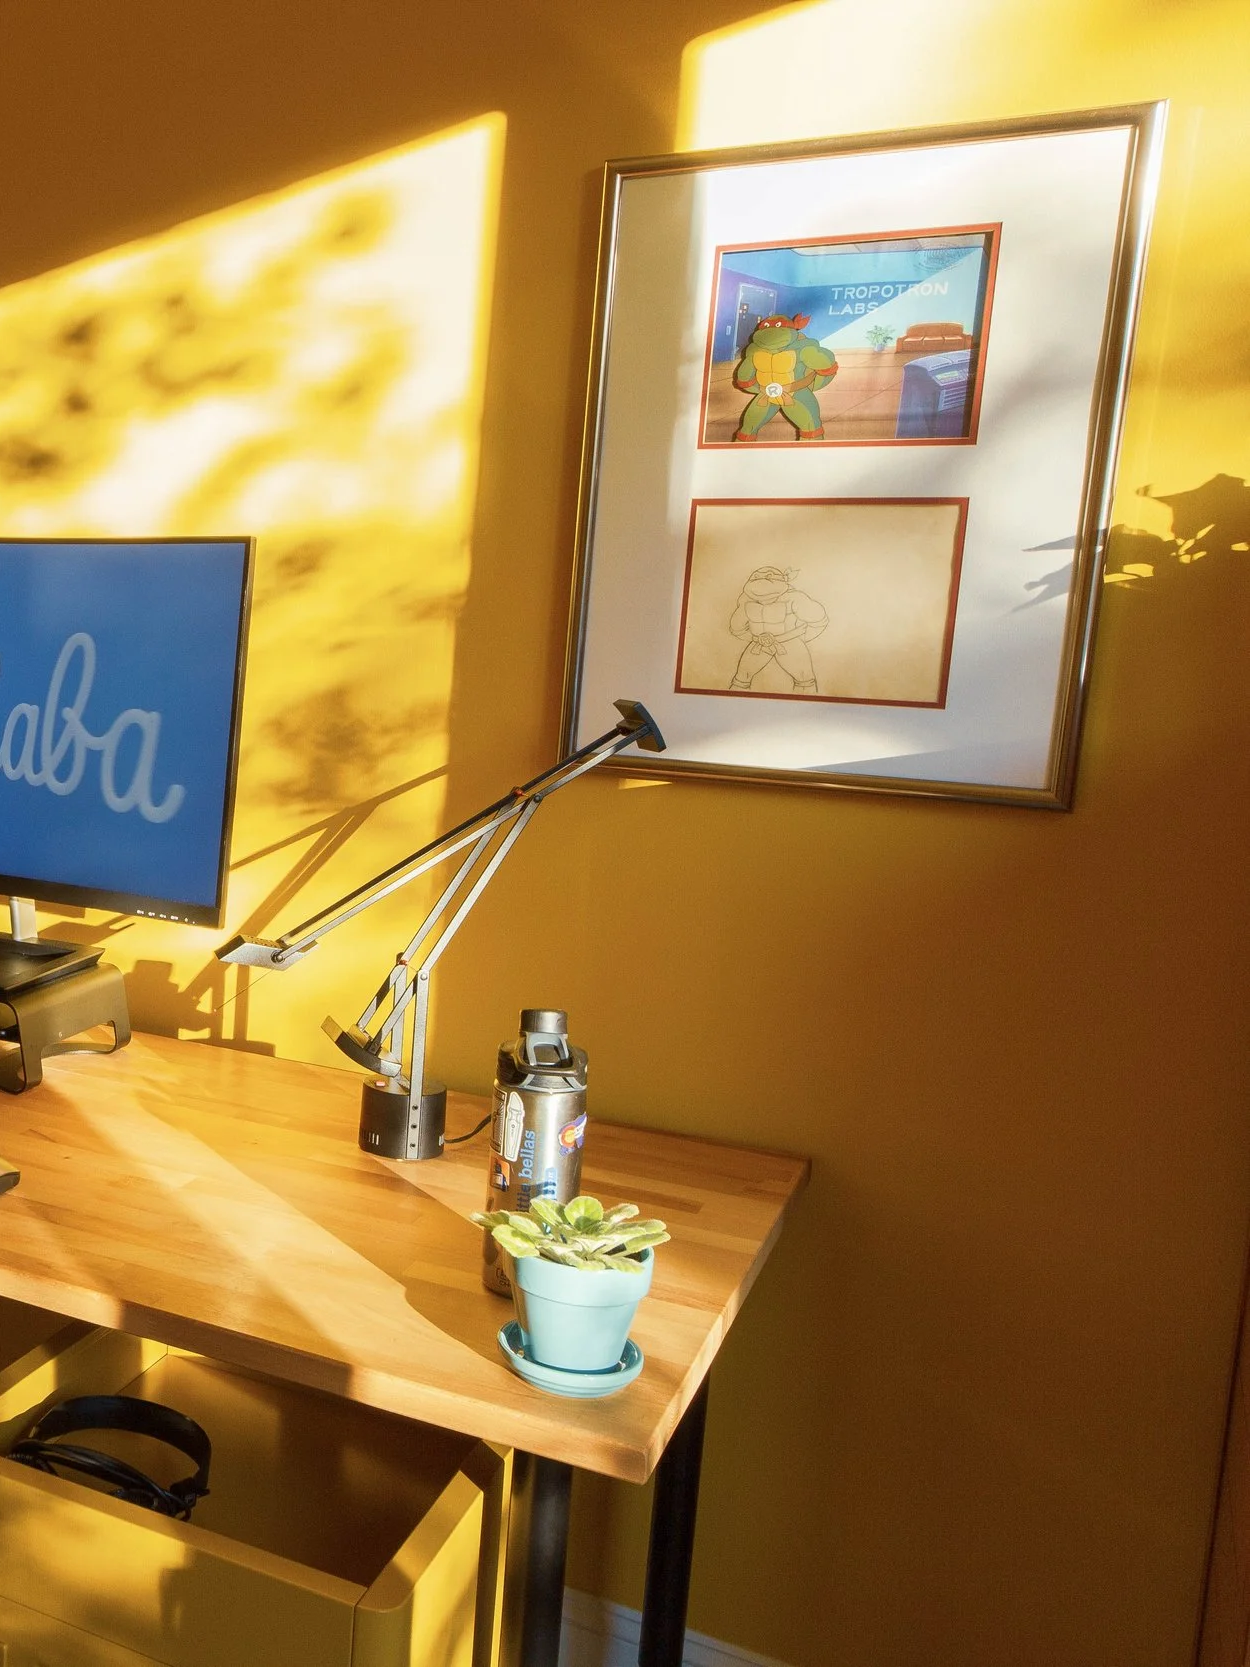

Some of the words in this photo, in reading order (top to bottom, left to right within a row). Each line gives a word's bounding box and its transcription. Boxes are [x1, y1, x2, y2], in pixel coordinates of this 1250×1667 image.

[831, 281, 949, 301] TROPOTRON
[828, 301, 879, 316] LABS
[767, 385, 779, 396] R
[518, 1130, 536, 1180] bellas
[516, 1183, 532, 1213] ittle
